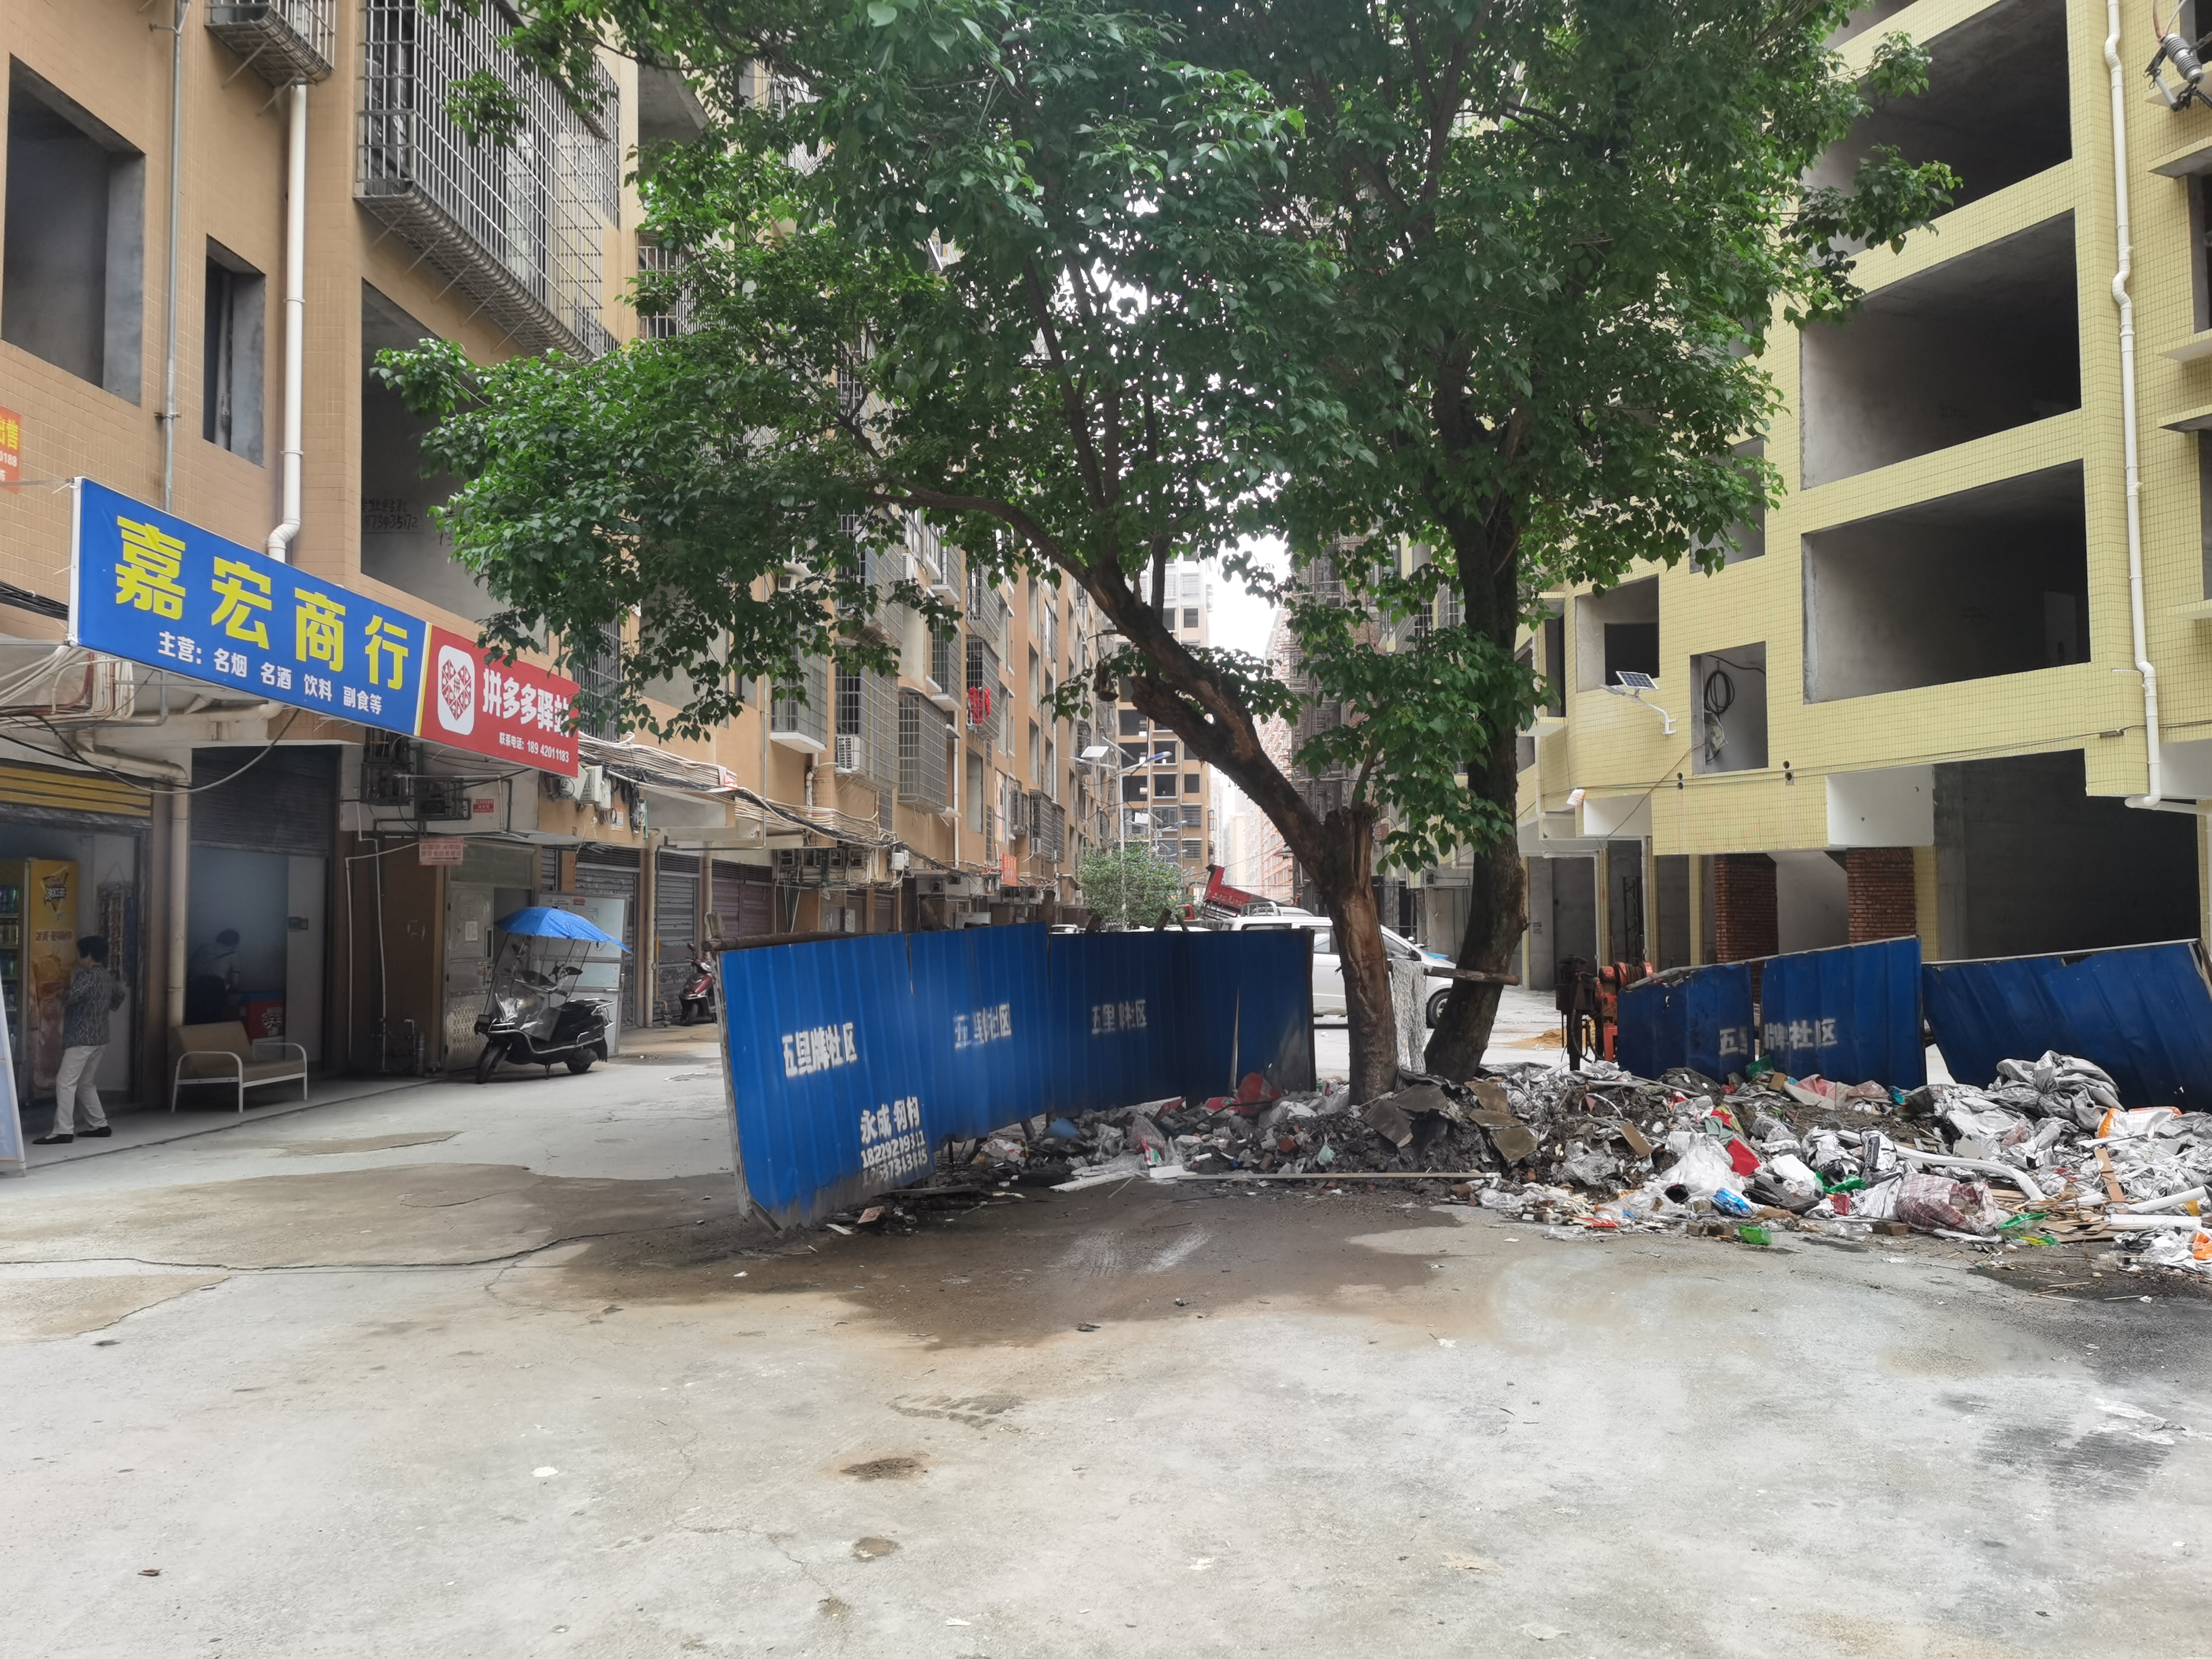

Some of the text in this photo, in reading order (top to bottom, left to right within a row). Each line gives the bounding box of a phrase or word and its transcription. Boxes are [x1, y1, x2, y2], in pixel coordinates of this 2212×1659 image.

[115, 515, 408, 690] 嘉宏商行
[214, 648, 247, 678] 名烟
[261, 662, 292, 690] 名酒
[304, 673, 332, 702] 饮料
[343, 685, 382, 715] 副食等
[527, 740, 539, 754] 189
[540, 744, 569, 763] 42011183
[781, 1022, 858, 1078] 五里牌社区
